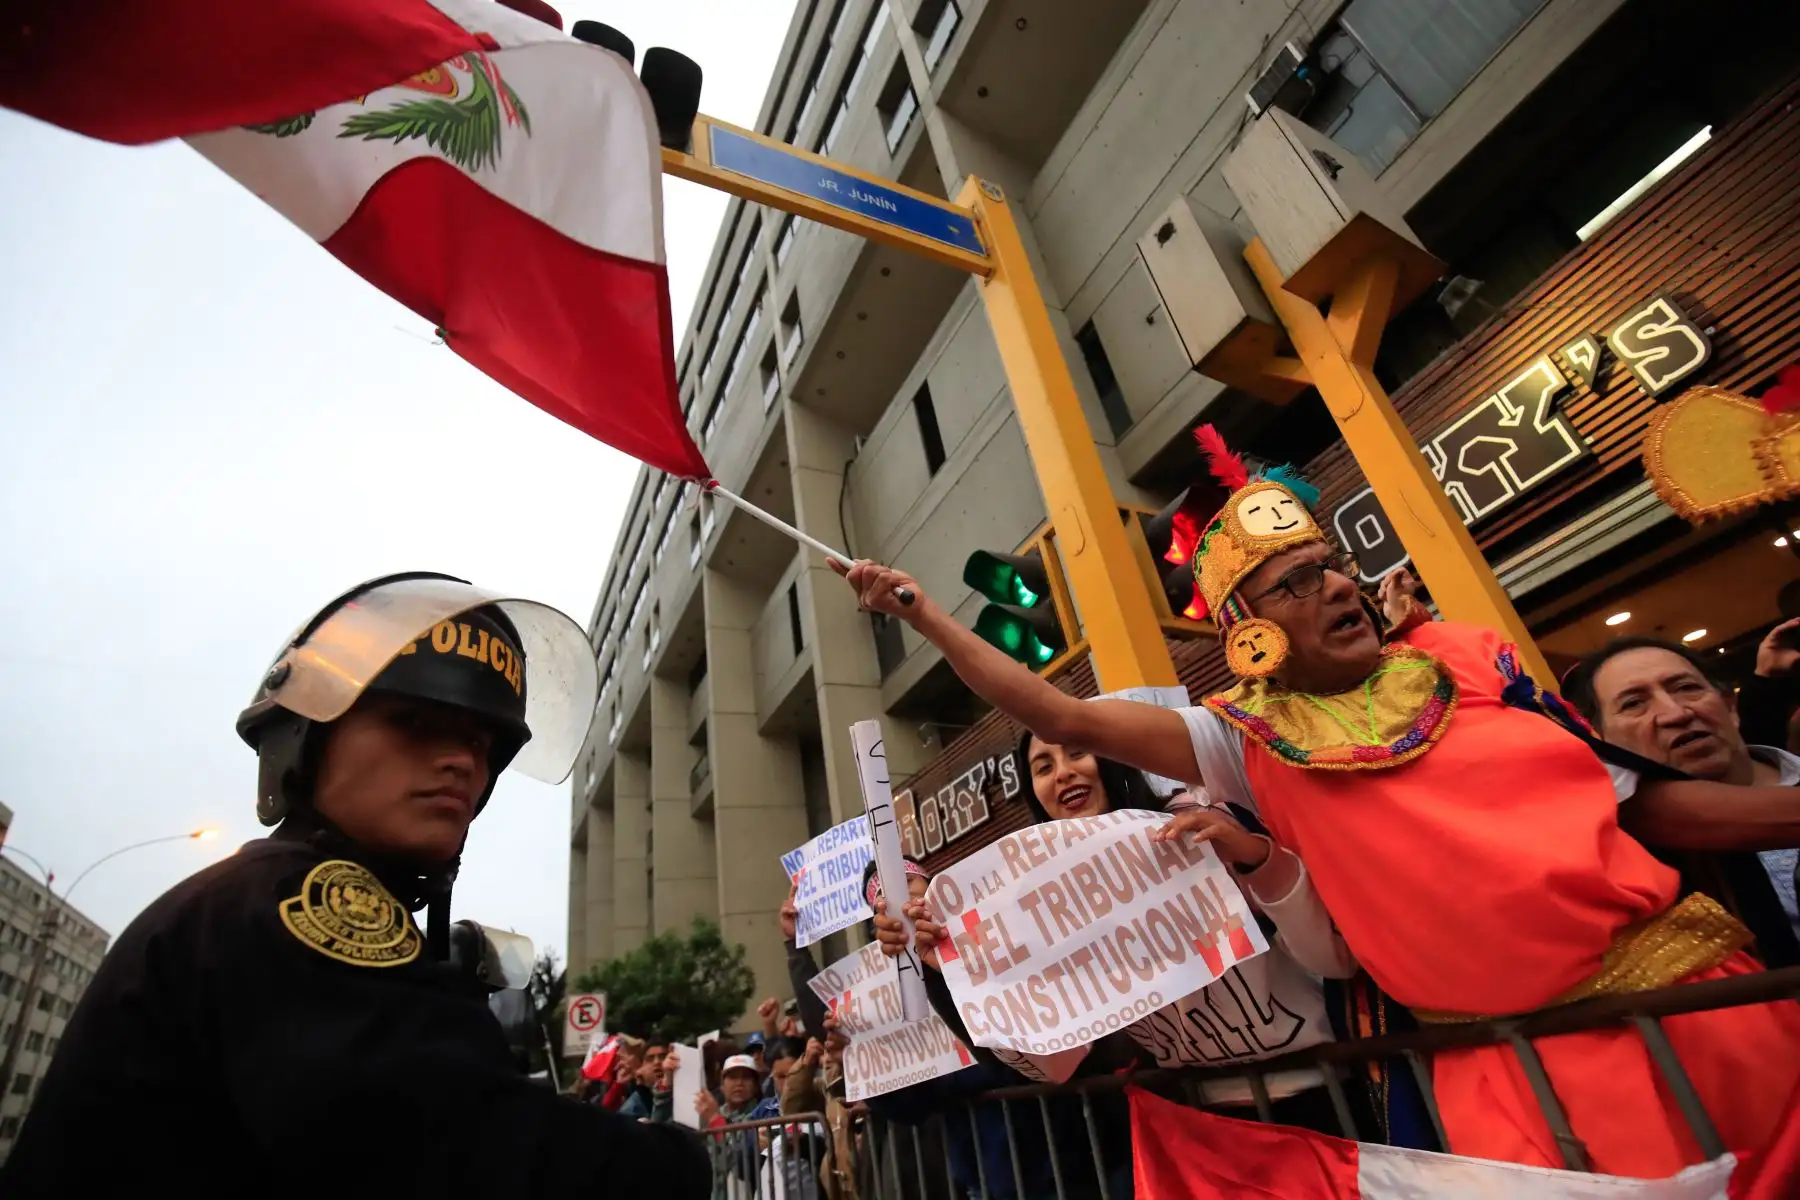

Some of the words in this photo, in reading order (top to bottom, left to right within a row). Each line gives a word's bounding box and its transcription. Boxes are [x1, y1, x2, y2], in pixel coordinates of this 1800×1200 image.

[817, 177, 843, 195] JR.
[848, 187, 897, 213] JUNÍN
[400, 619, 521, 697] OLICIA
[783, 849, 805, 876] NO
[970, 881, 985, 904] A
[981, 869, 1006, 896] LA
[954, 912, 1032, 987] DEL
[1017, 825, 1205, 948] TRIBUNAL
[961, 876, 1245, 1037] CONSTITUCIONAL
[811, 968, 845, 1000] NO
